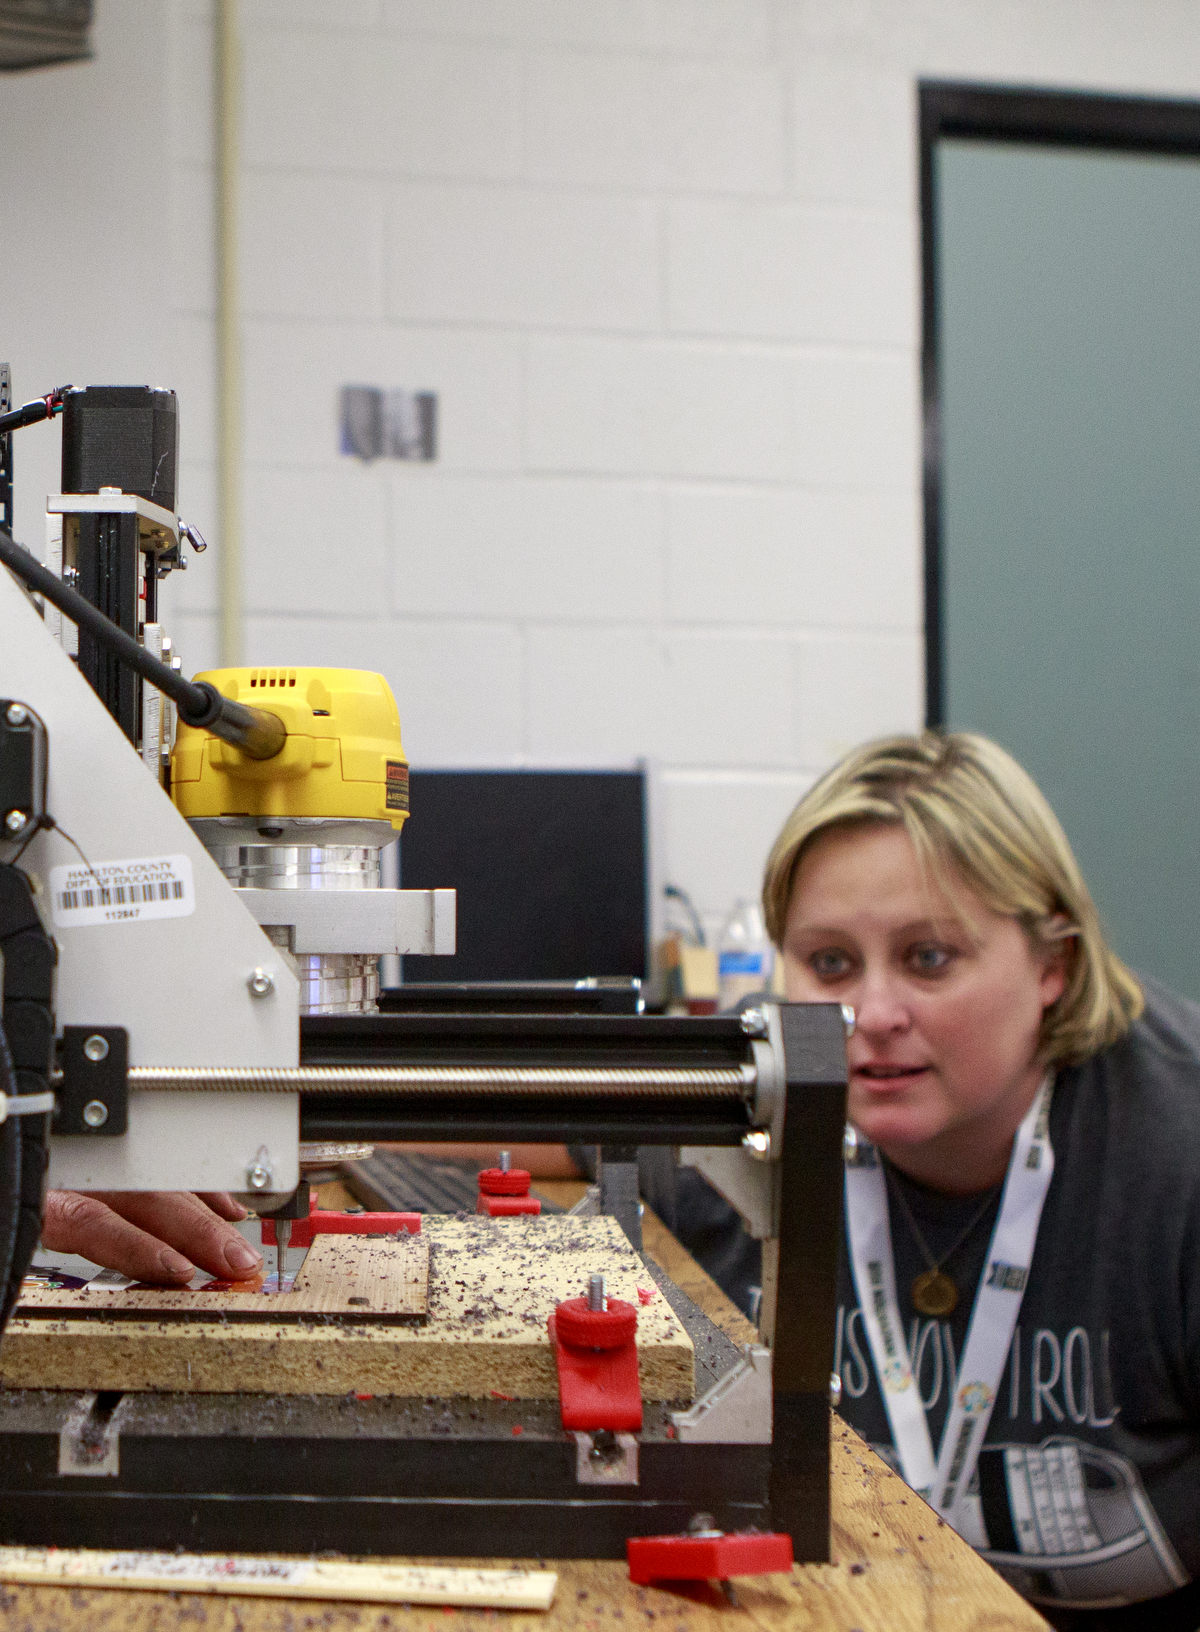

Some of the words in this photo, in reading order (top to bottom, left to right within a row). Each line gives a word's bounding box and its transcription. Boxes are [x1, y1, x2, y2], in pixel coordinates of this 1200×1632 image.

[68, 867, 124, 878] HAMILTON
[127, 862, 172, 874] COUNTY
[114, 872, 176, 884] EDUCATION
